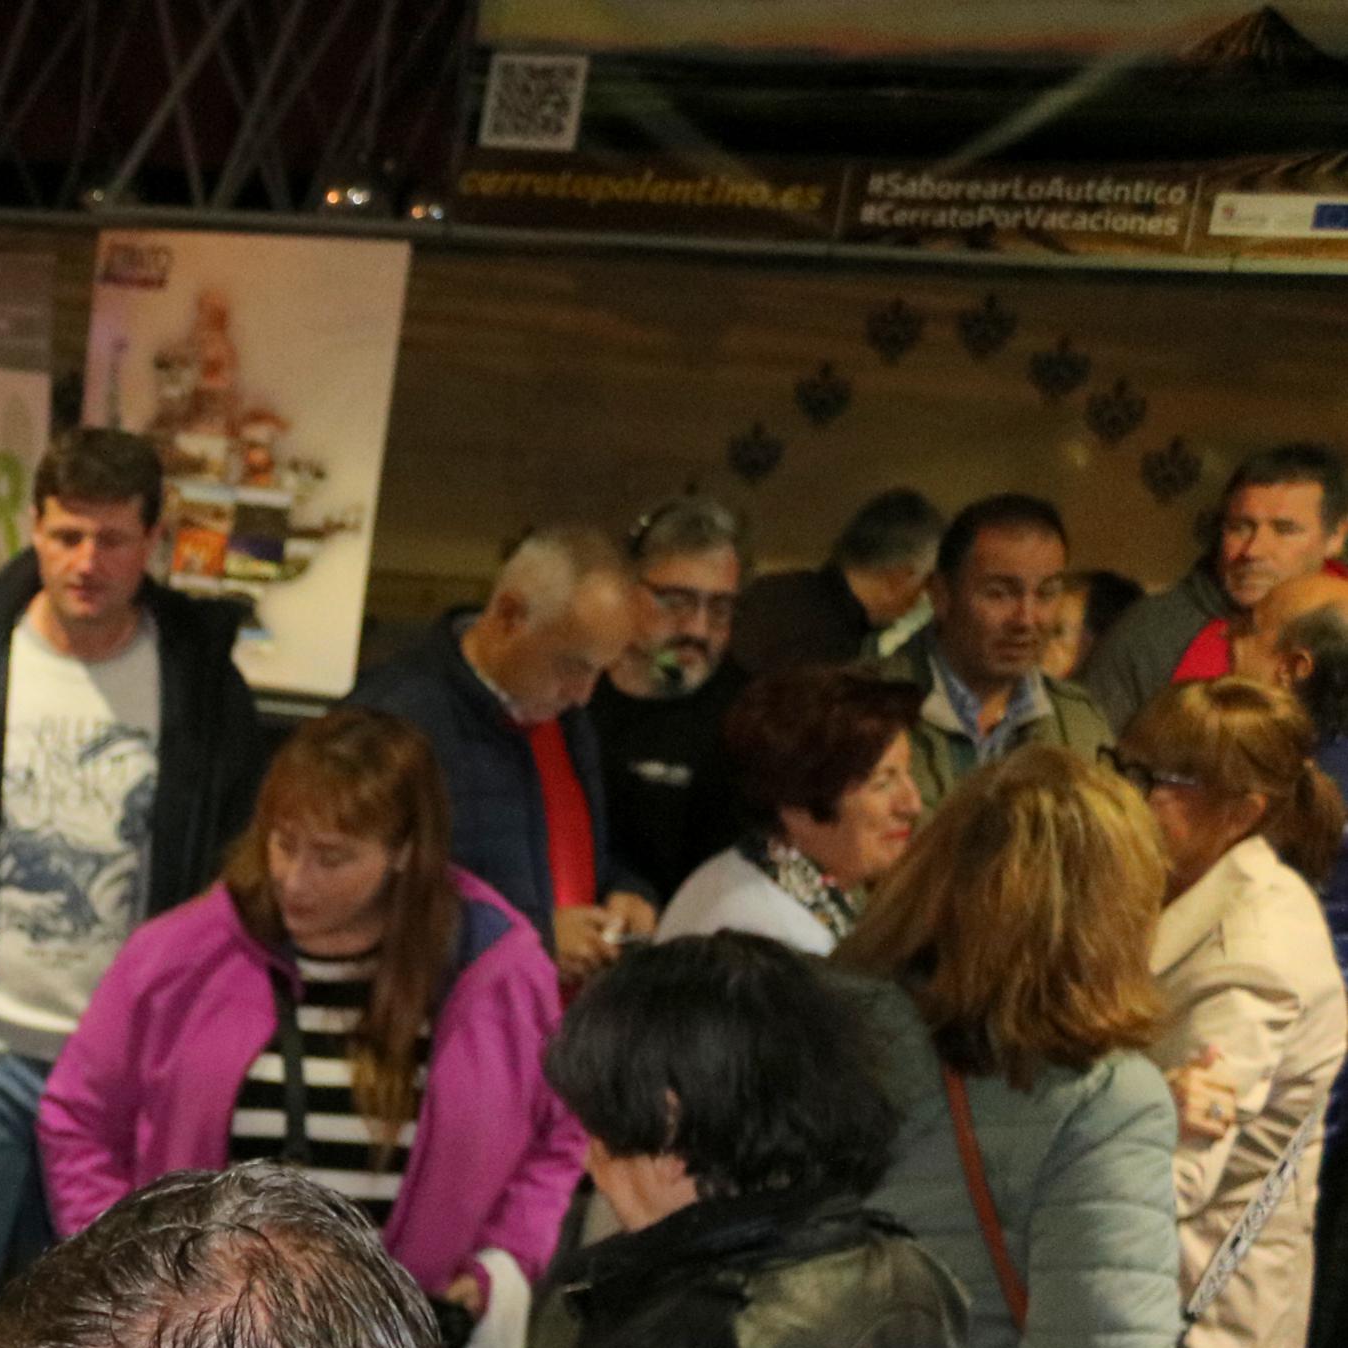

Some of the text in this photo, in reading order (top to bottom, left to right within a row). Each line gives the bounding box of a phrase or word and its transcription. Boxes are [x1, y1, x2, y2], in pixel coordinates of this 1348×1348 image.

[459, 168, 825, 210] cerratopalentino.es
[866, 172, 1187, 206] #SaborearLoAuténtico
[860, 202, 1181, 237] #CerratoPorVacaciones
